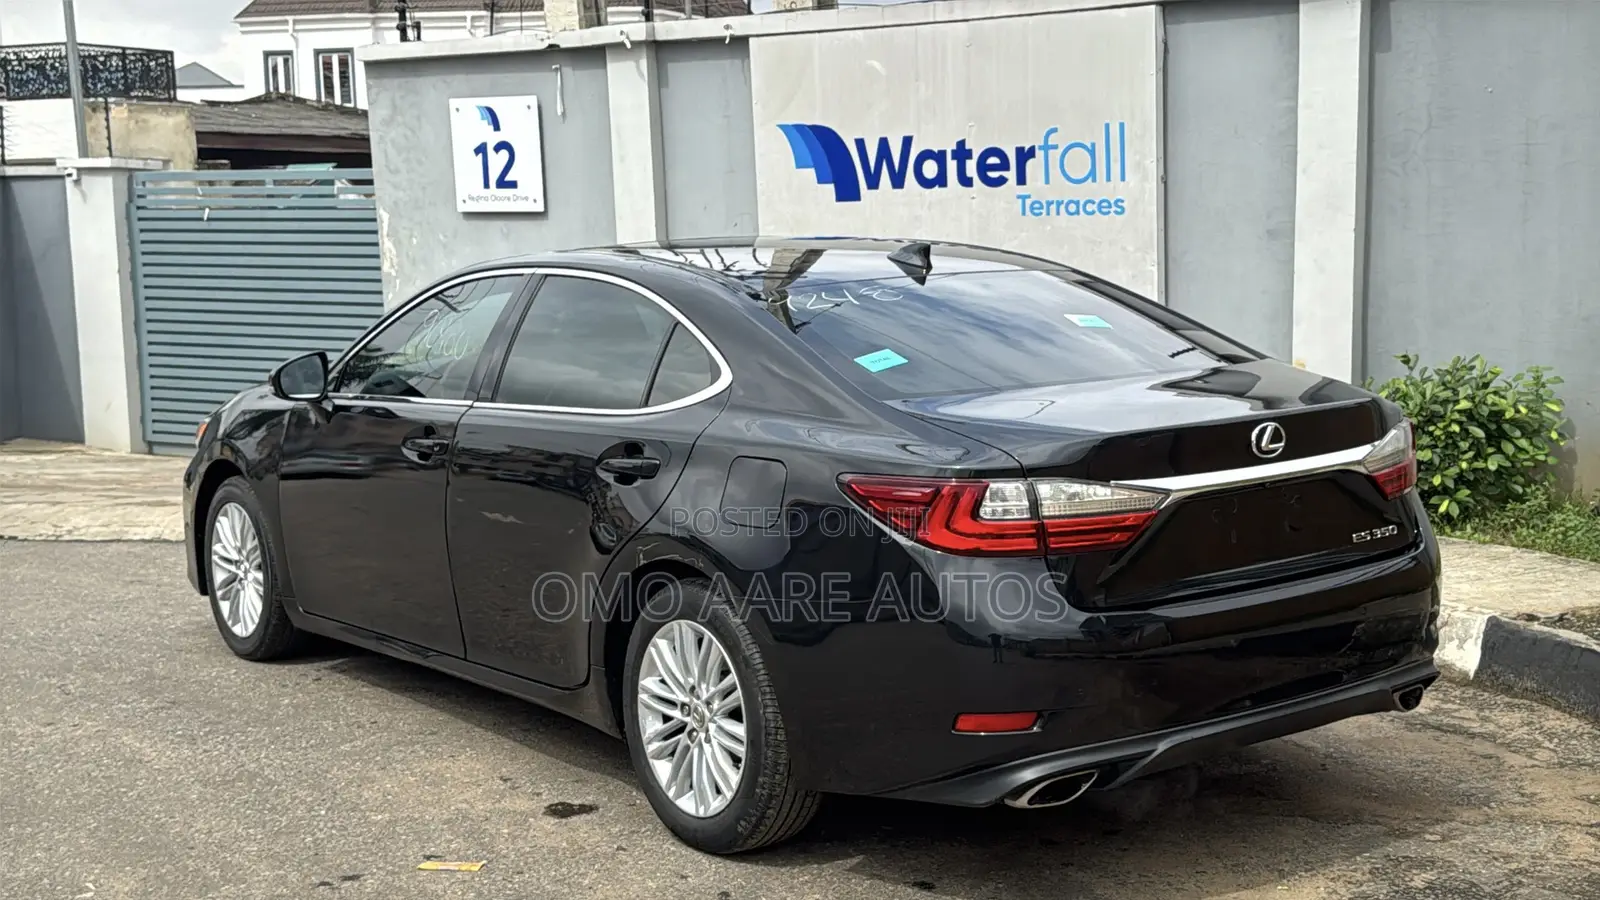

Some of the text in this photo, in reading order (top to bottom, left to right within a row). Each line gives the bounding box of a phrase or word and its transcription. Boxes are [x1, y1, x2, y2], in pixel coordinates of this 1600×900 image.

[473, 140, 518, 189] 12
[854, 122, 1126, 190] Waterfall
[512, 193, 529, 202] Drive
[1016, 193, 1126, 217] Terraces
[1352, 525, 1397, 543] ES 350
